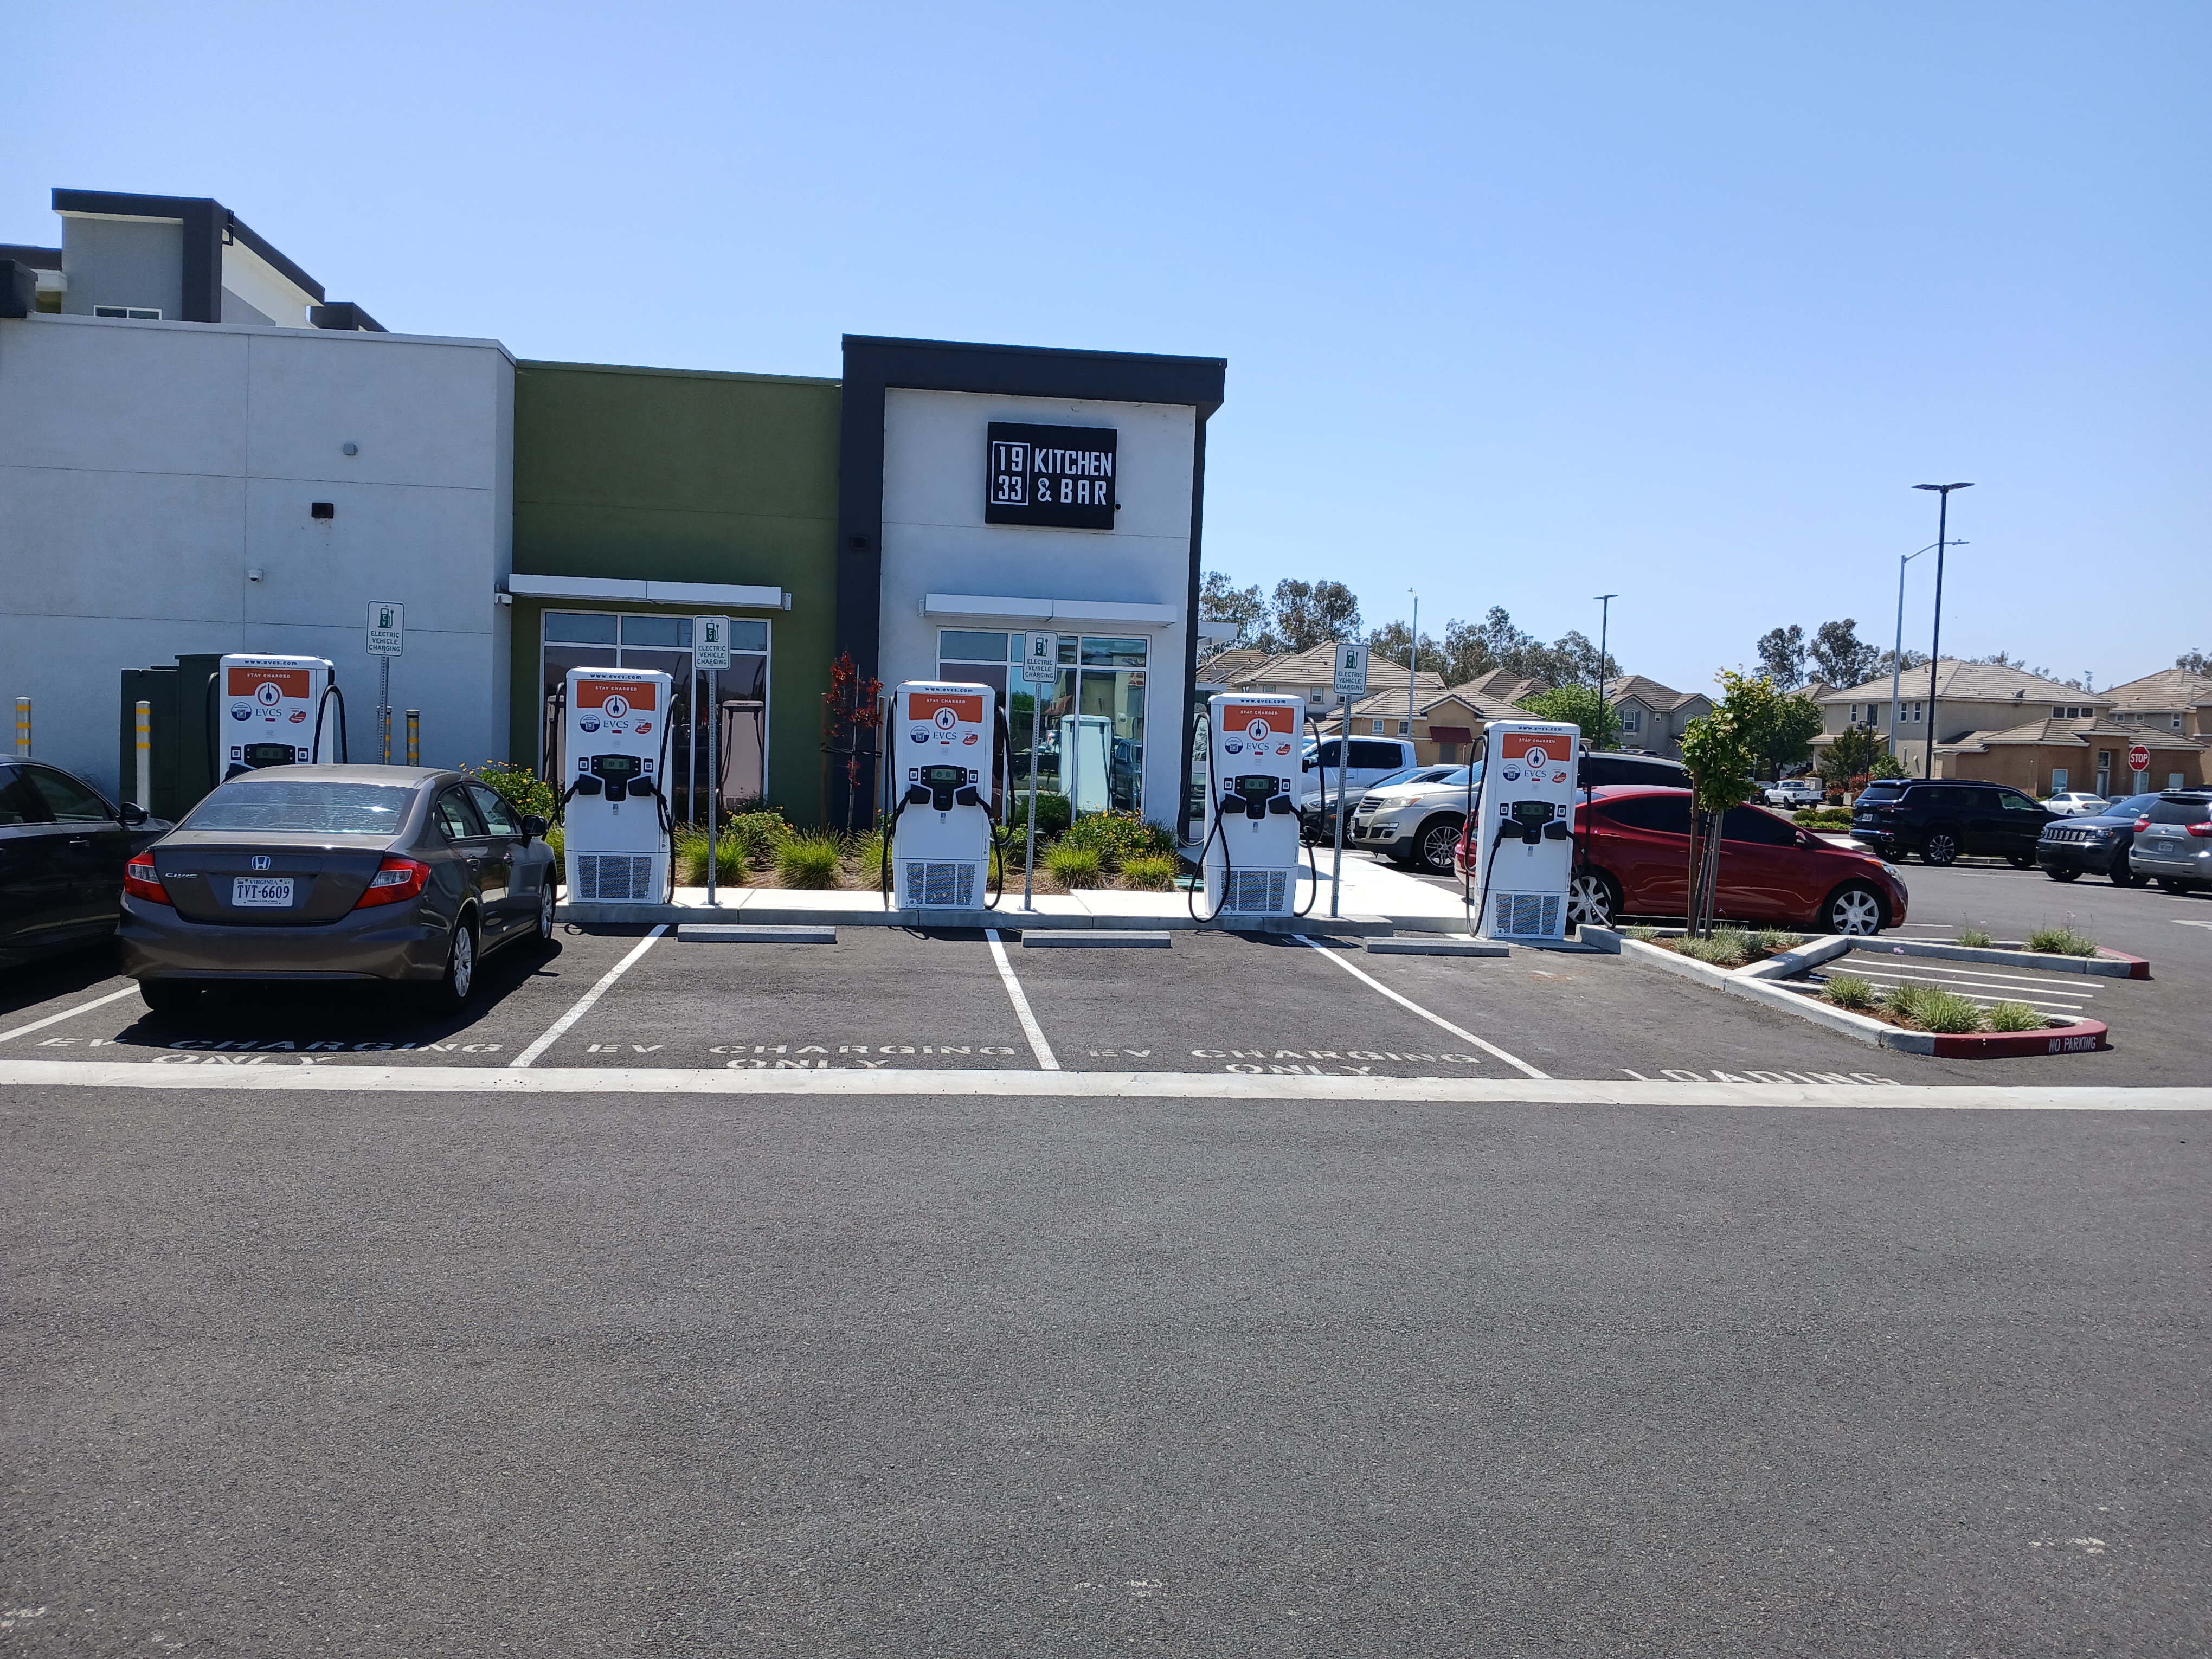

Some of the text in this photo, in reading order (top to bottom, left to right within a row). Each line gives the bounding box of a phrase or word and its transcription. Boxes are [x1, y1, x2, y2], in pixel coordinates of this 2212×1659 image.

[999, 446, 1023, 471] 19
[1034, 448, 1112, 477] KITCHEN
[998, 475, 1021, 500] 33
[1037, 478, 1106, 505] & BAR
[255, 708, 282, 717] EVCS
[603, 720, 629, 729] EVCS
[933, 732, 957, 740] EVCS
[2130, 754, 2148, 763] STOP
[237, 885, 290, 898] TVT-6609
[35, 1038, 503, 1052] EV CHARGING
[587, 1044, 1015, 1055] EV CHARGING
[2049, 1036, 2096, 1053] NO PARKING
[152, 1054, 336, 1065] ONLY
[1088, 1049, 1480, 1063] EV CHARGING
[726, 1059, 889, 1068] ONLY
[1225, 1064, 1371, 1075] ONLY
[1619, 1068, 1900, 1086] LOADING
